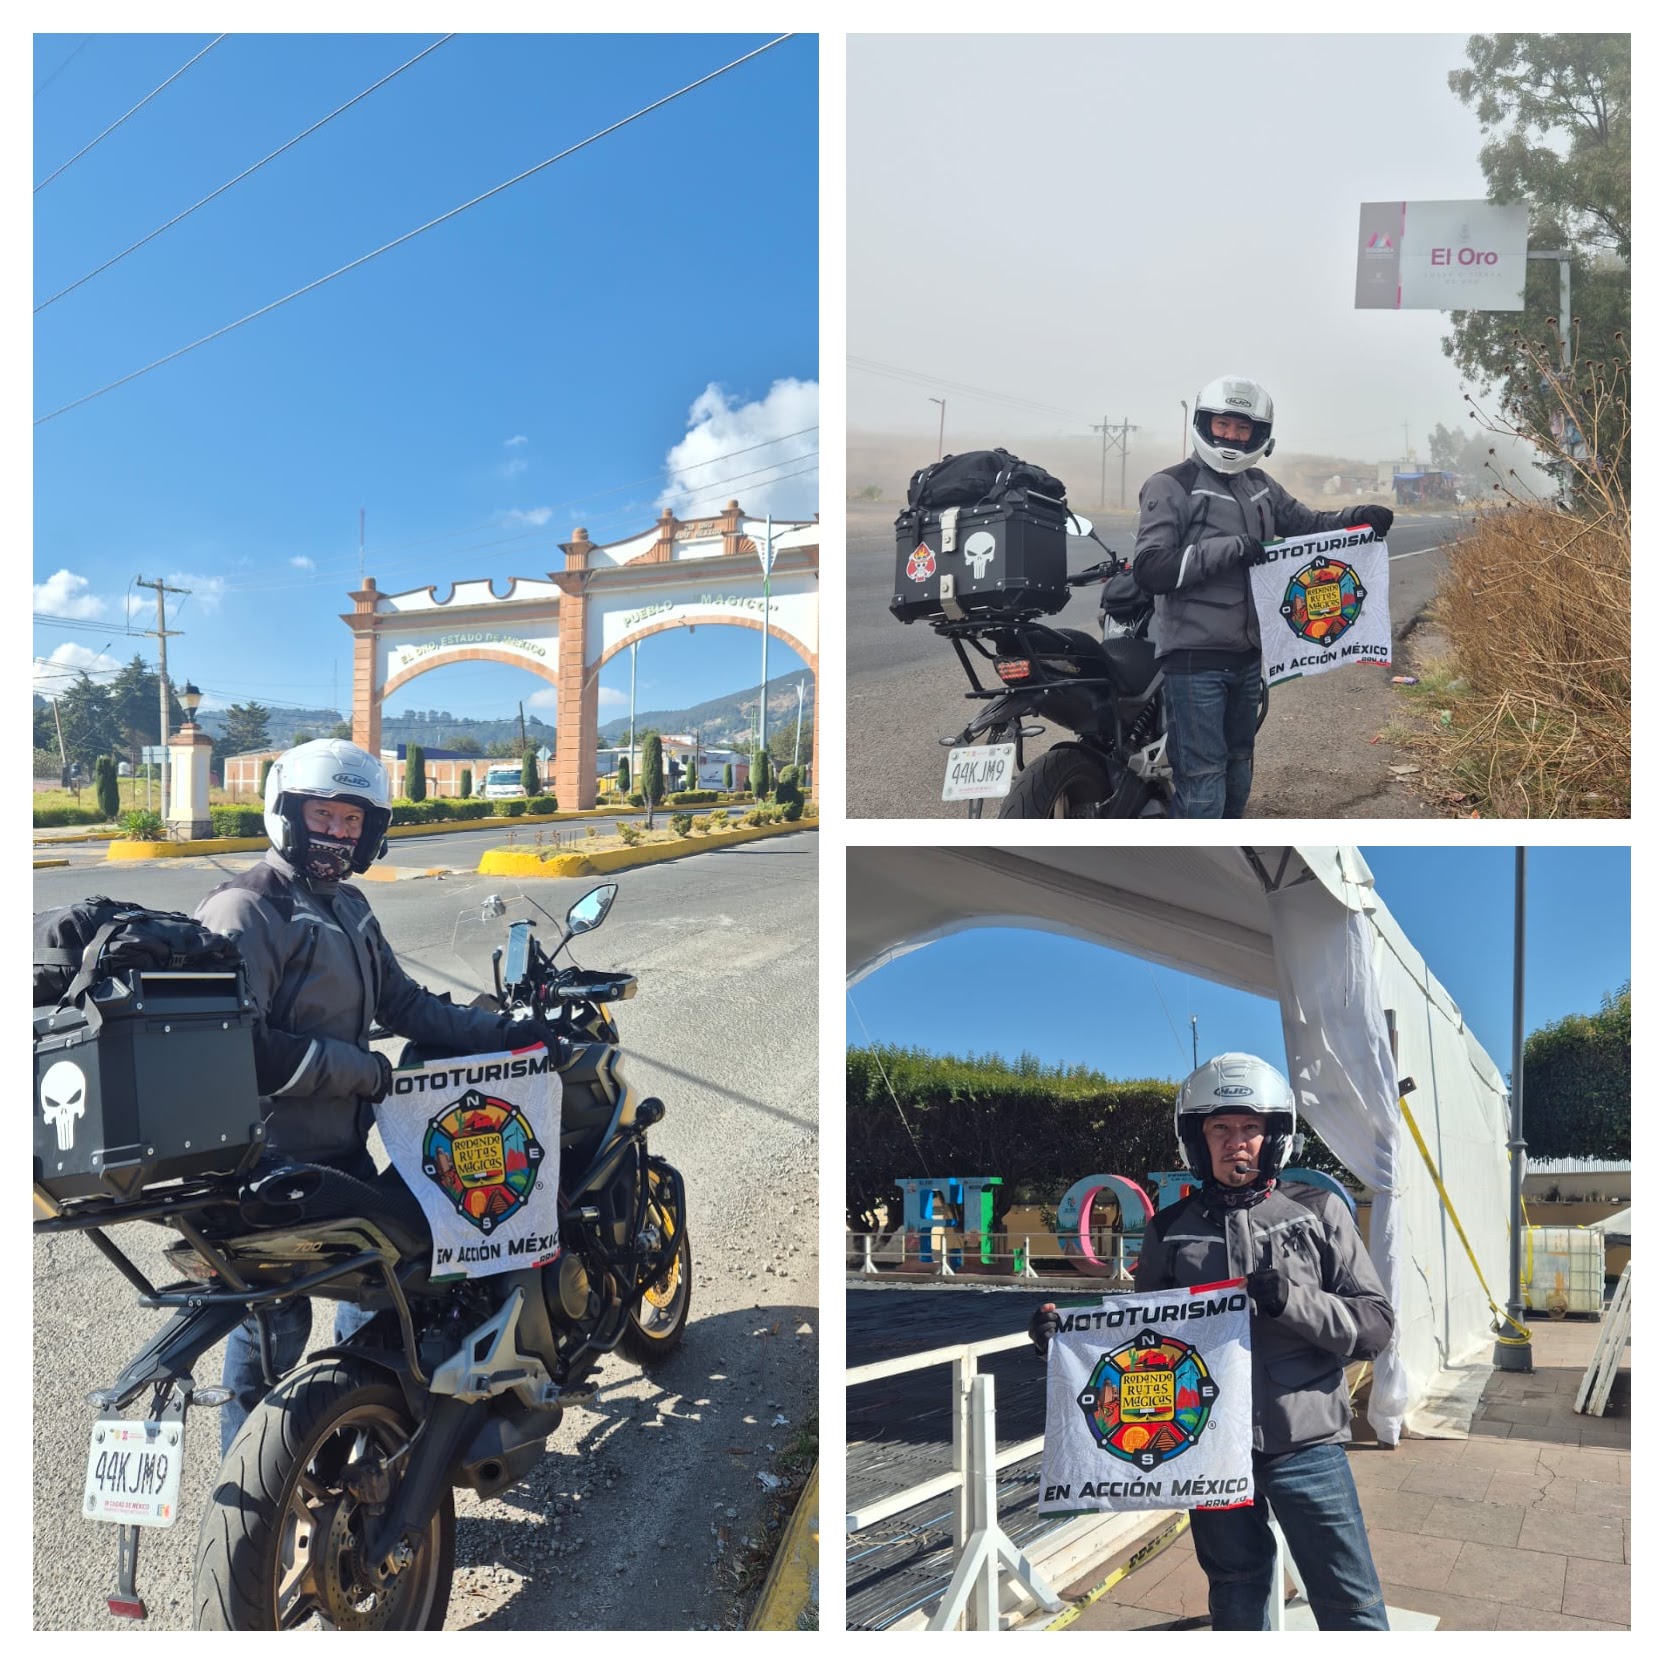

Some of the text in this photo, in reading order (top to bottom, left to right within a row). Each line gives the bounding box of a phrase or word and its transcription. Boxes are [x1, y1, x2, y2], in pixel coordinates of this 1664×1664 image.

[1431, 247, 1498, 266] El Oro
[1315, 559, 1325, 567] N
[624, 599, 674, 628] PUEBLO
[440, 632, 483, 646] ESTADO
[1324, 636, 1331, 644] S
[1269, 642, 1388, 678] EN ACCIÓN MÉXICO
[952, 760, 1005, 785] 44KJM9
[466, 1095, 480, 1107] N
[529, 1148, 540, 1158] E
[425, 1165, 437, 1175] O
[482, 1217, 492, 1229] S
[293, 1241, 323, 1253] 700
[436, 1247, 453, 1265] EN
[457, 1240, 501, 1264] ACCIÓN
[1054, 1294, 1247, 1334] MOTOTURISMO
[1142, 1335, 1156, 1346] N
[1202, 1386, 1214, 1397] E
[1081, 1394, 1095, 1405] O
[1141, 1453, 1154, 1466] S
[95, 1450, 168, 1495] 44KJM9
[1044, 1474, 1249, 1502] EN ACCIÓN MÉXICO
